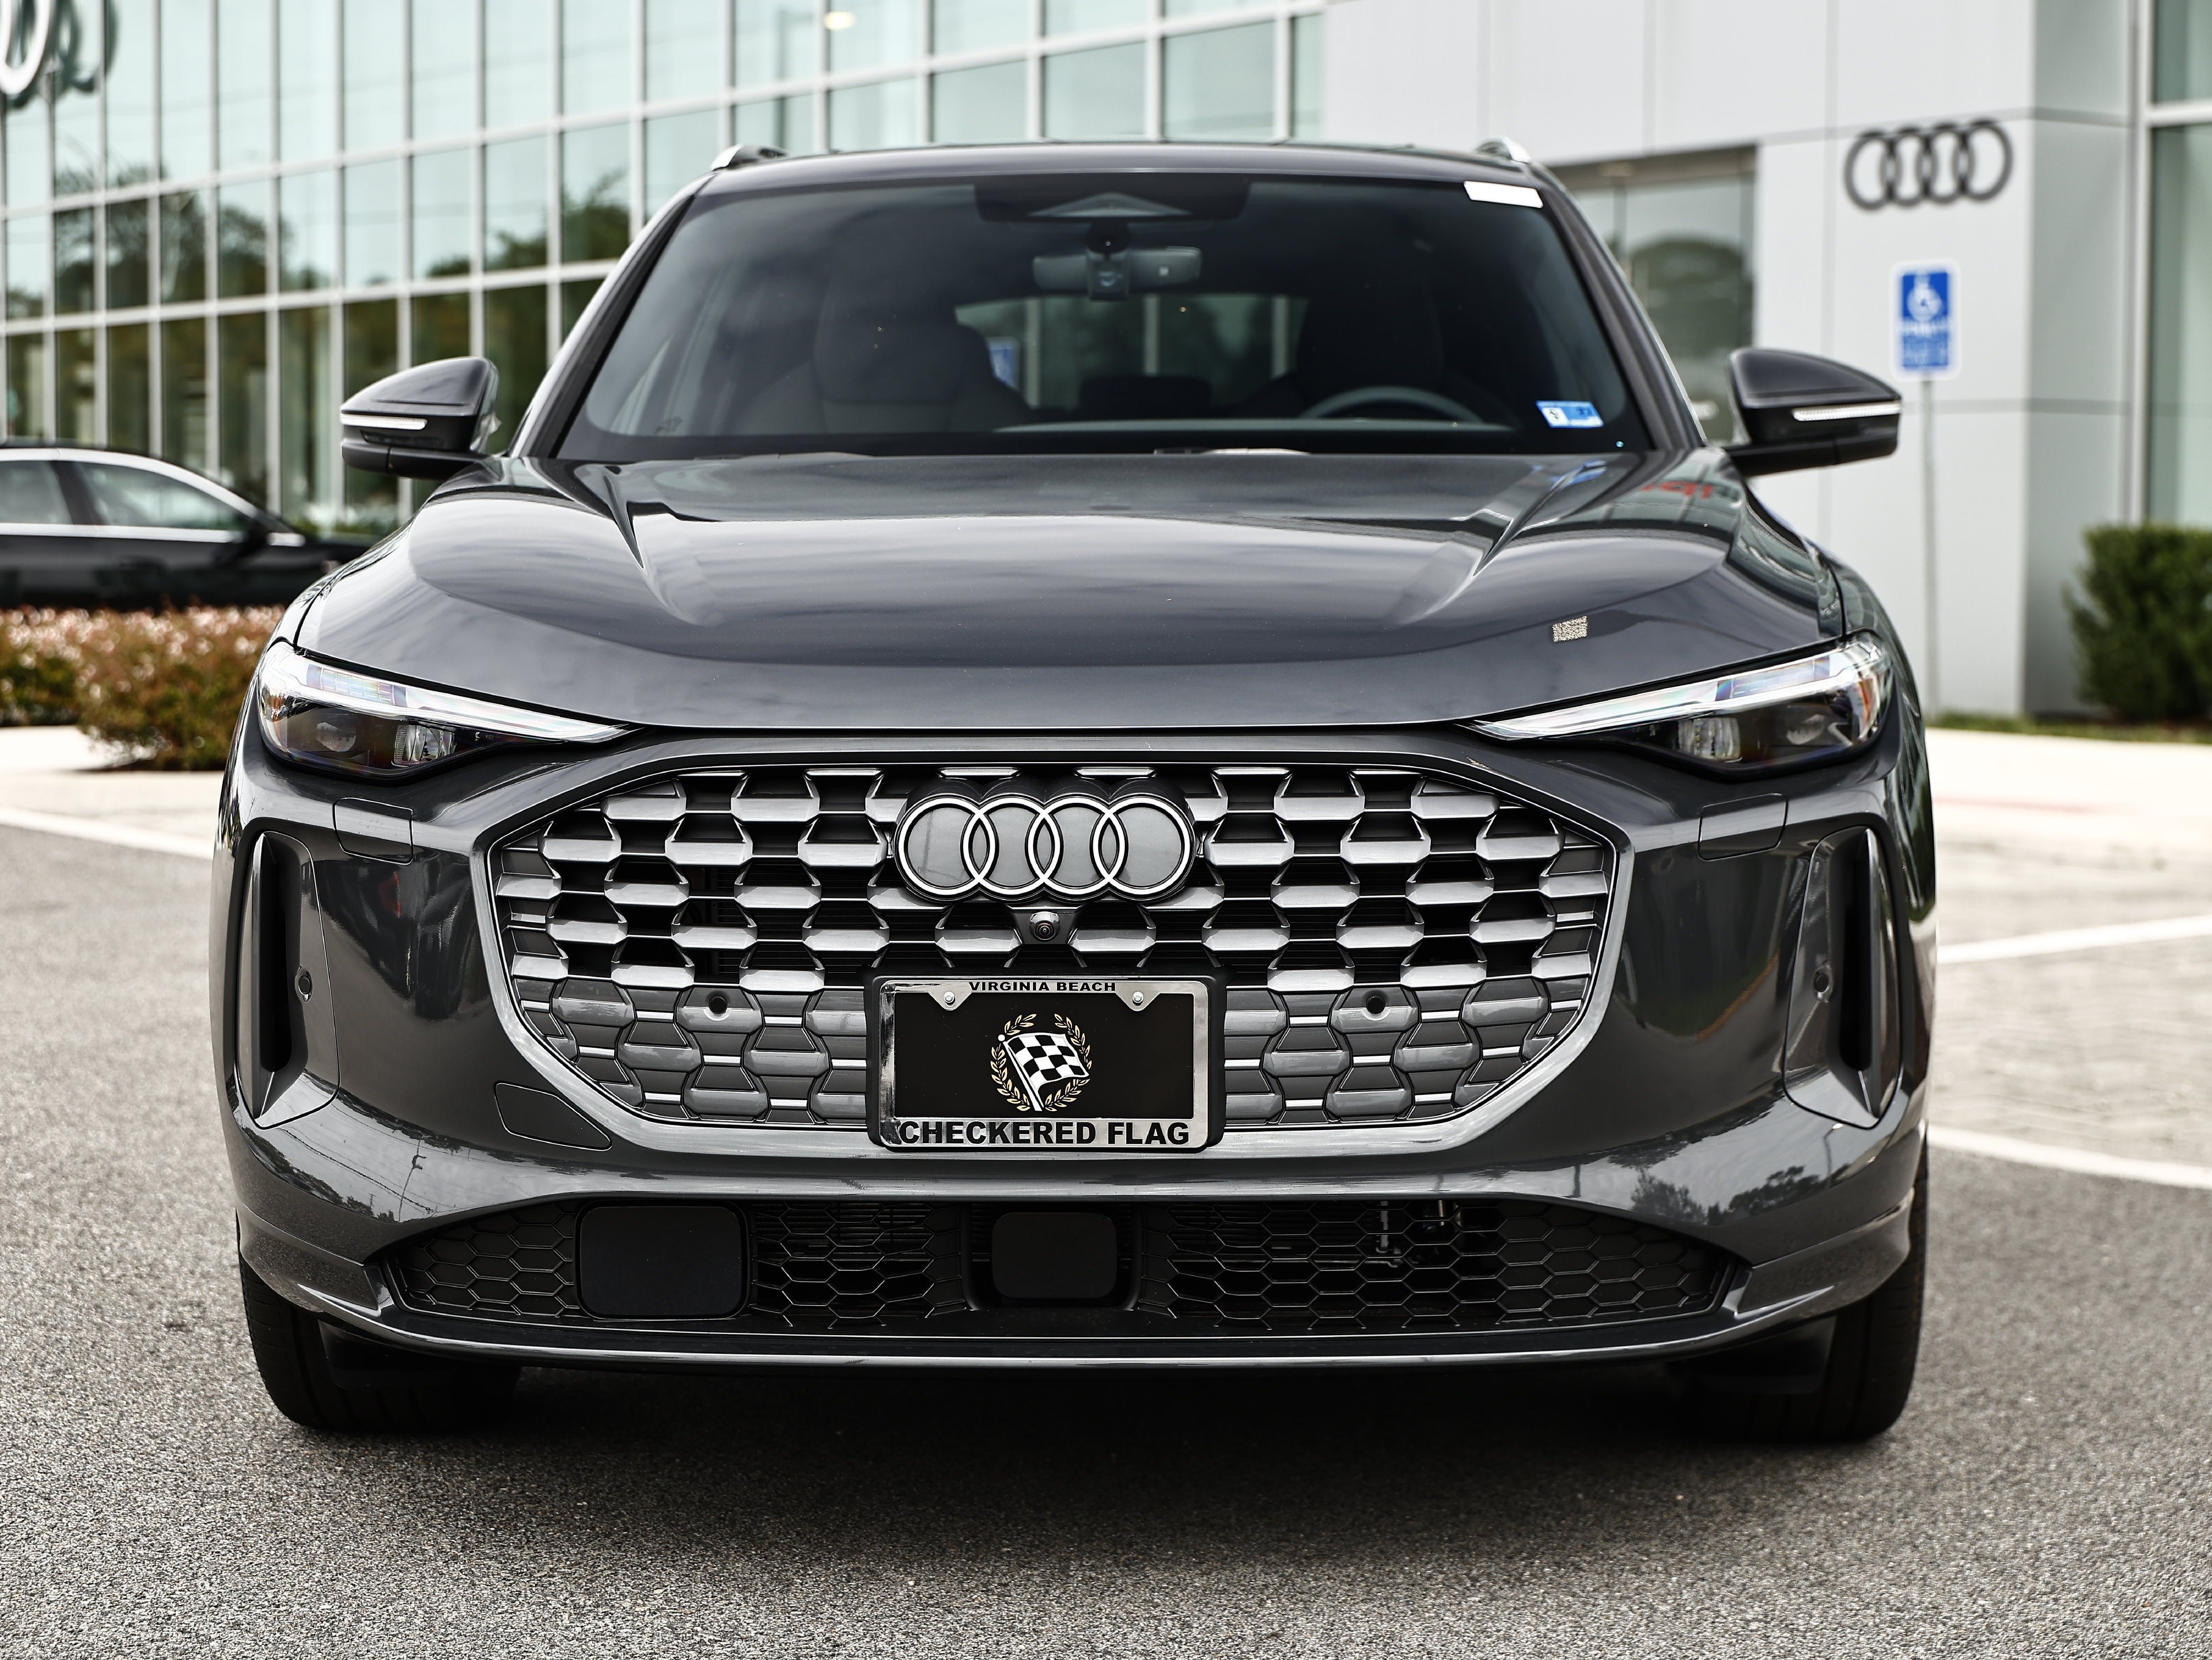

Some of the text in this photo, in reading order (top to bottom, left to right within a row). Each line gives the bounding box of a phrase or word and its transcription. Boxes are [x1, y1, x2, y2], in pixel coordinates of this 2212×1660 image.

[968, 981, 1116, 991] VIRGINIA BEACH
[899, 1120, 1190, 1145] CHECKERED FLAG
